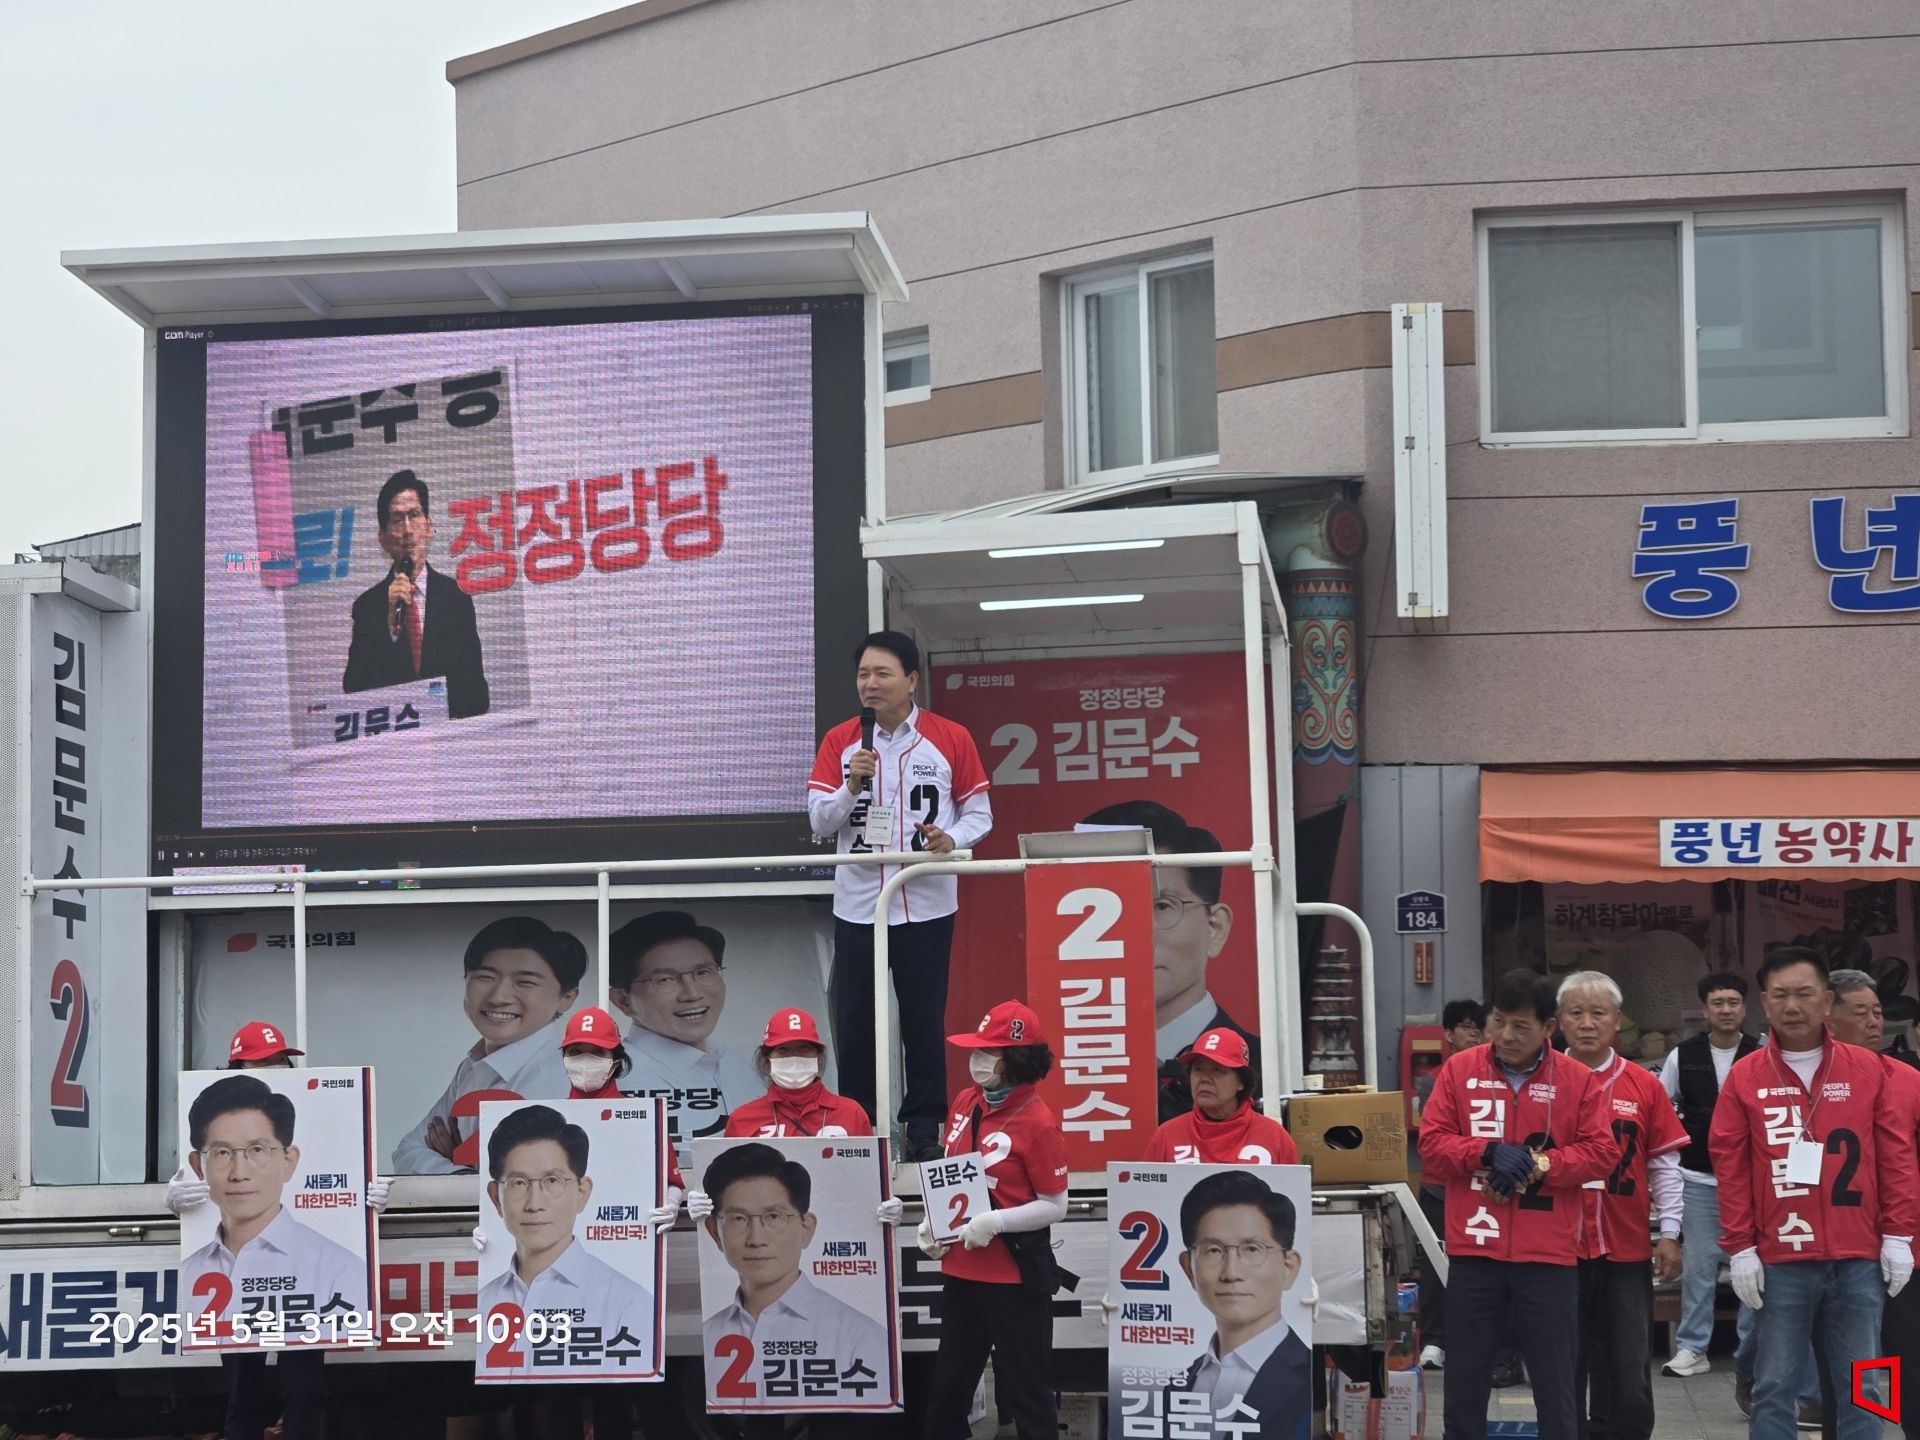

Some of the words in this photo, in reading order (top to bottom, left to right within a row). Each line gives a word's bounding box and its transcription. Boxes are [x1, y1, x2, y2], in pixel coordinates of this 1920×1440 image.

[448, 454, 728, 596] 정정당당
[967, 674, 1015, 687] 국민의힘
[1079, 686, 1165, 711] 정정당당
[990, 723, 1040, 786] 2
[1053, 716, 1200, 782] 김문수
[1056, 887, 1125, 961] 2
[1405, 911, 1438, 928] 184
[581, 1015, 594, 1032] 2
[788, 1014, 801, 1030] 2
[1010, 1019, 1025, 1041] 2
[50, 959, 89, 1128] 2
[262, 1028, 277, 1044] 2
[1204, 1034, 1220, 1050] 2
[1060, 977, 1132, 1142] 김문수
[321, 1078, 354, 1089] 국민의힘
[1823, 1083, 1851, 1091] PEOPLE
[614, 1109, 647, 1120] 국민의힘
[836, 1148, 871, 1158] 국민의힘
[1608, 1119, 1641, 1197] 2
[927, 1160, 978, 1189] 김문수
[1825, 1128, 1863, 1207] 2
[304, 1174, 348, 1190] 새롭게
[1133, 1173, 1168, 1183] 국민의힘
[295, 1192, 357, 1209] 대한민국!
[596, 1205, 638, 1222] 새롭게
[948, 1192, 973, 1231] 2
[586, 1225, 648, 1241] 대한민국!
[822, 1241, 867, 1258] 새롭게
[1118, 1210, 1170, 1291] 2
[813, 1259, 878, 1276] 대한민국!
[192, 1271, 234, 1337] 2
[241, 1276, 297, 1292] 정정당당
[1121, 1303, 1172, 1322] 새롭게
[1121, 1325, 1195, 1345] 대한민국!
[713, 1334, 757, 1398] 2
[762, 1340, 818, 1356] 정정당당
[763, 1357, 879, 1398] 김문수
[1121, 1367, 1190, 1387] 정정당당
[1121, 1391, 1261, 1440] 김문수
